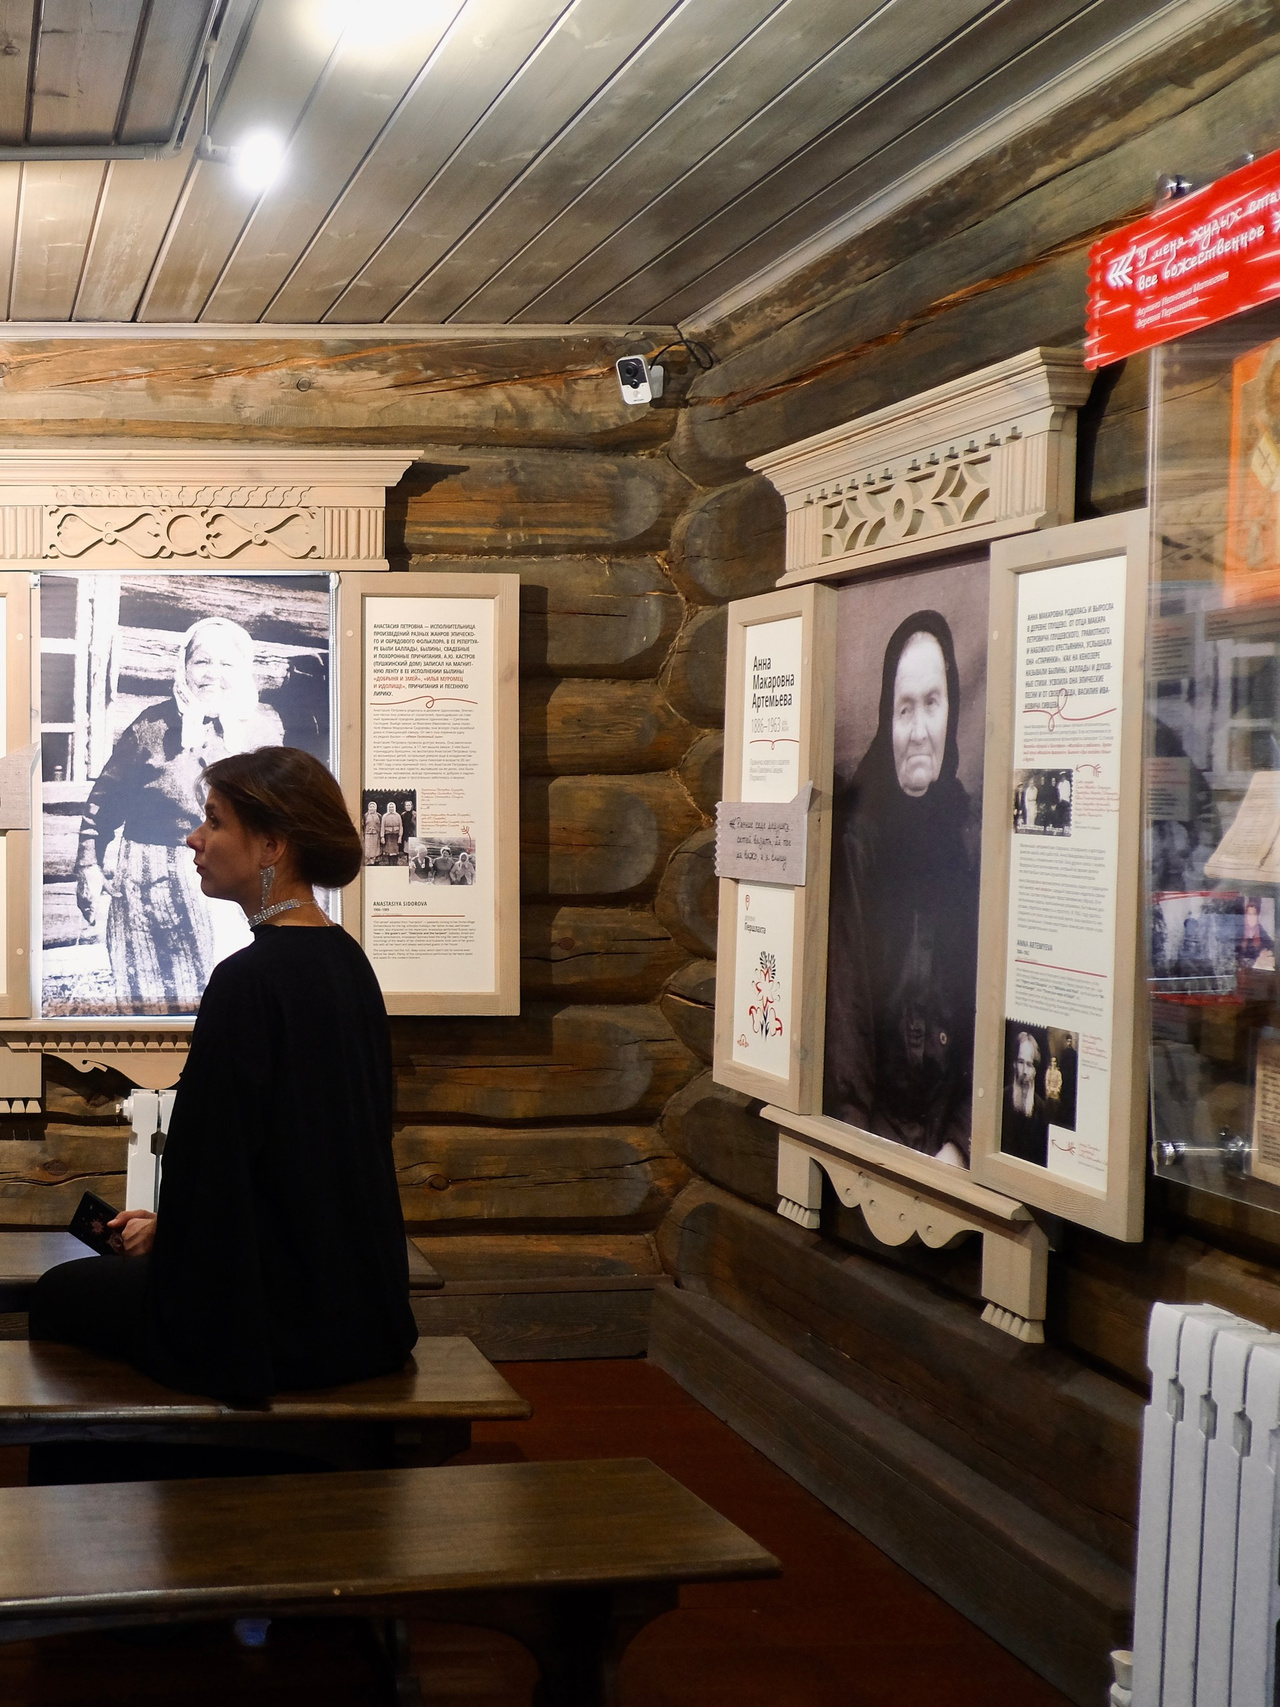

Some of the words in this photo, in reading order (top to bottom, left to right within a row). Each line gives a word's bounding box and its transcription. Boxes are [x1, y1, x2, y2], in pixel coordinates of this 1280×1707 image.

[1138, 274, 1158, 291] все
[1164, 225, 1265, 280] божественное
[1152, 237, 1187, 260] меня
[753, 656, 771, 671] Анна
[752, 674, 795, 692] Макаровна
[752, 693, 792, 712] Артемьева
